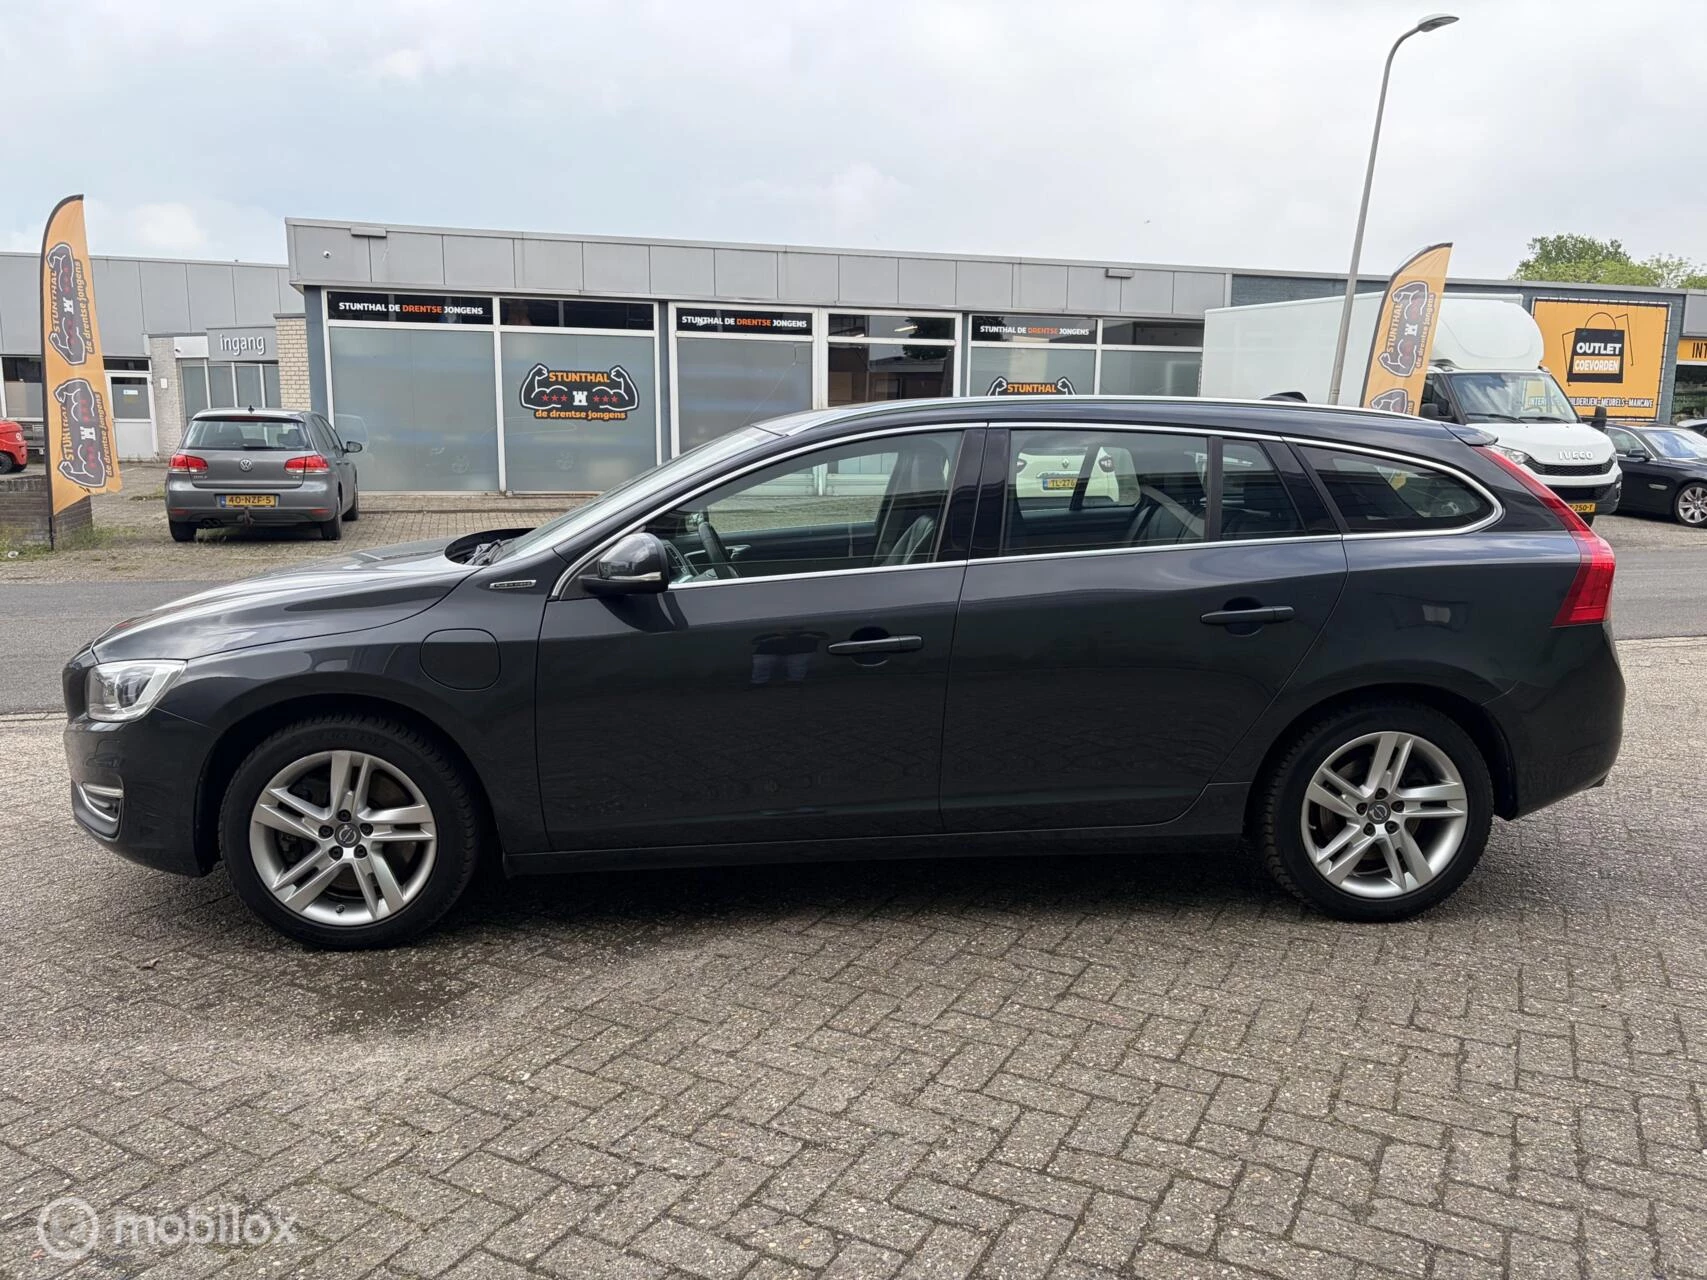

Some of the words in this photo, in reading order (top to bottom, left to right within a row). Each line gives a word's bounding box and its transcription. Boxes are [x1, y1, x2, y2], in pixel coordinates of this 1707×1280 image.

[74, 261, 87, 301] jongens
[51, 270, 60, 333] STUNTHAL
[338, 302, 387, 312] STUNTHAL
[388, 304, 401, 312] DE
[402, 304, 442, 314] DRENTSE
[444, 306, 484, 315] JONGENS
[80, 302, 91, 338] drentse
[681, 316, 723, 325] STUNTHAL
[736, 318, 772, 327] DRENTSE
[772, 319, 807, 328] JONGENS
[980, 325, 1016, 334] STUNTHAL
[1027, 326, 1058, 335] DRENTSE
[1059, 328, 1090, 336] JONGENS
[1386, 303, 1403, 353] STUNTHAL
[86, 342, 93, 353] de
[219, 333, 265, 356] ingang
[1576, 341, 1622, 354] OUTLET
[1574, 359, 1619, 371] COEVORDEN
[549, 372, 610, 383] STUNTHAL
[1007, 383, 1057, 393] STUNTHAL
[535, 410, 548, 418] de
[549, 410, 586, 418] drentse
[587, 410, 626, 420] jongens
[1559, 449, 1594, 460] IVECO
[228, 495, 272, 504] 40-NZF-5
